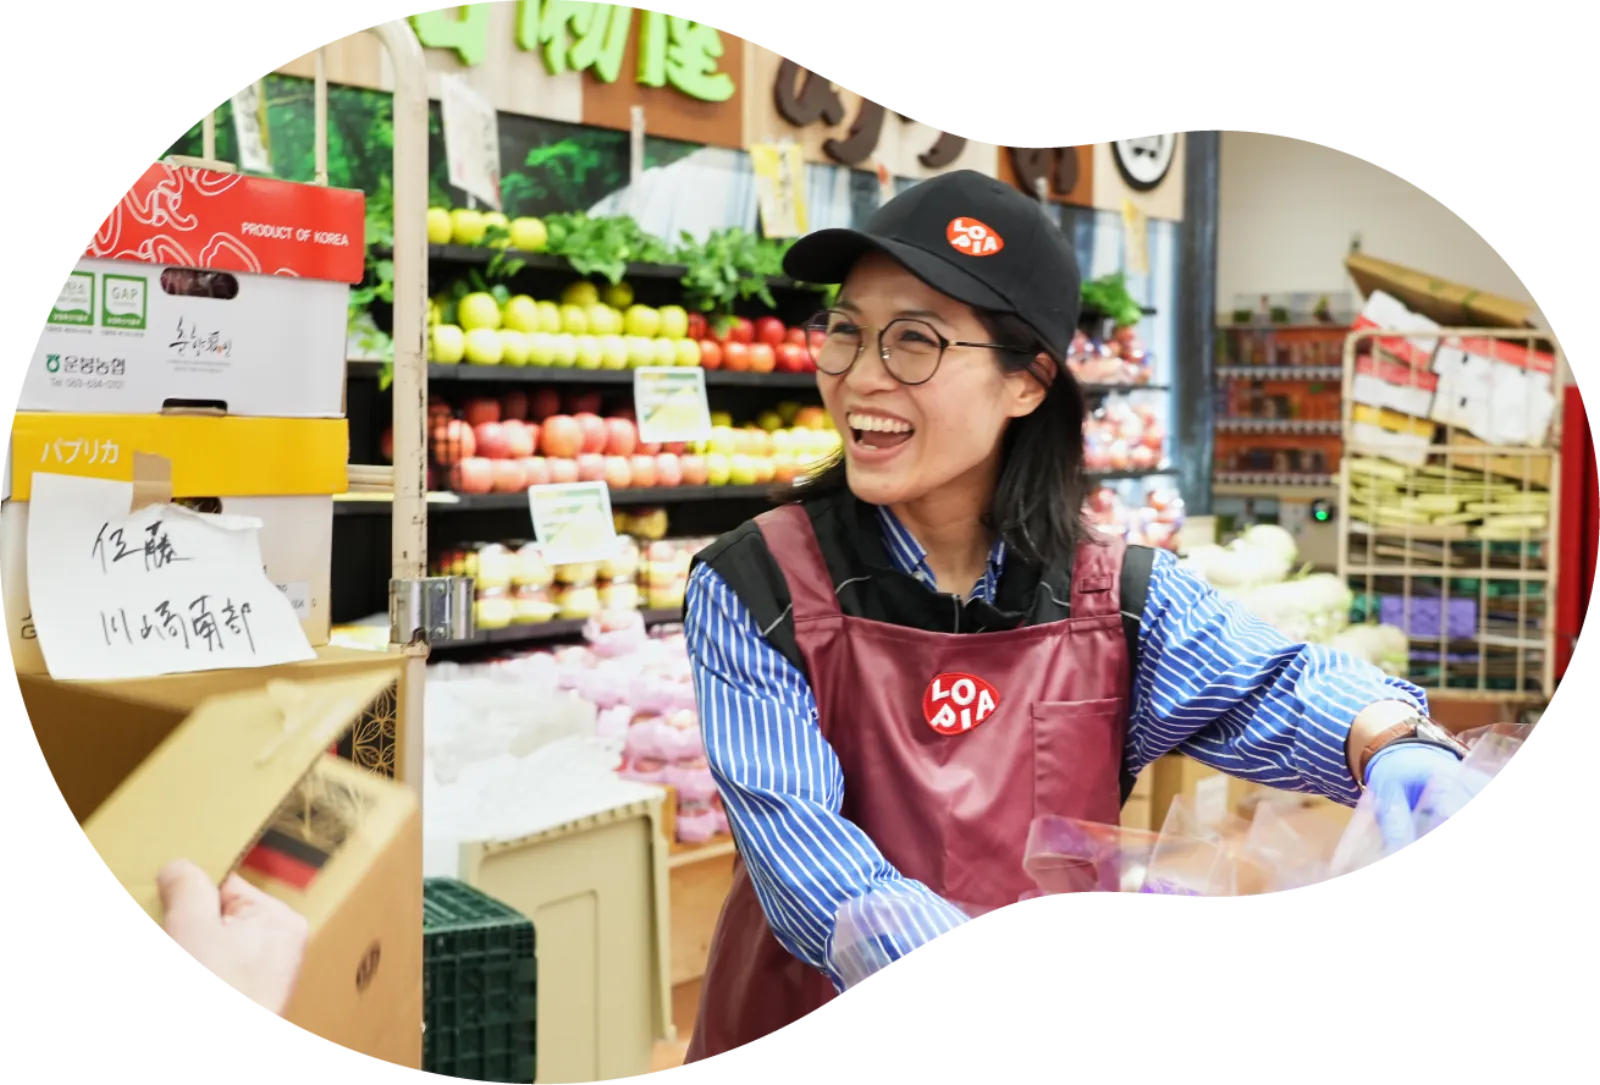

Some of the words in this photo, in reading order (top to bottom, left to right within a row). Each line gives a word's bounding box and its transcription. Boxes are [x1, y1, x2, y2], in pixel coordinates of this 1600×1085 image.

[241, 221, 293, 239] PRODUCT
[296, 228, 312, 242] OF
[313, 231, 349, 246] KOREA
[111, 285, 140, 301] GAP
[40, 436, 120, 465] パプリカ
